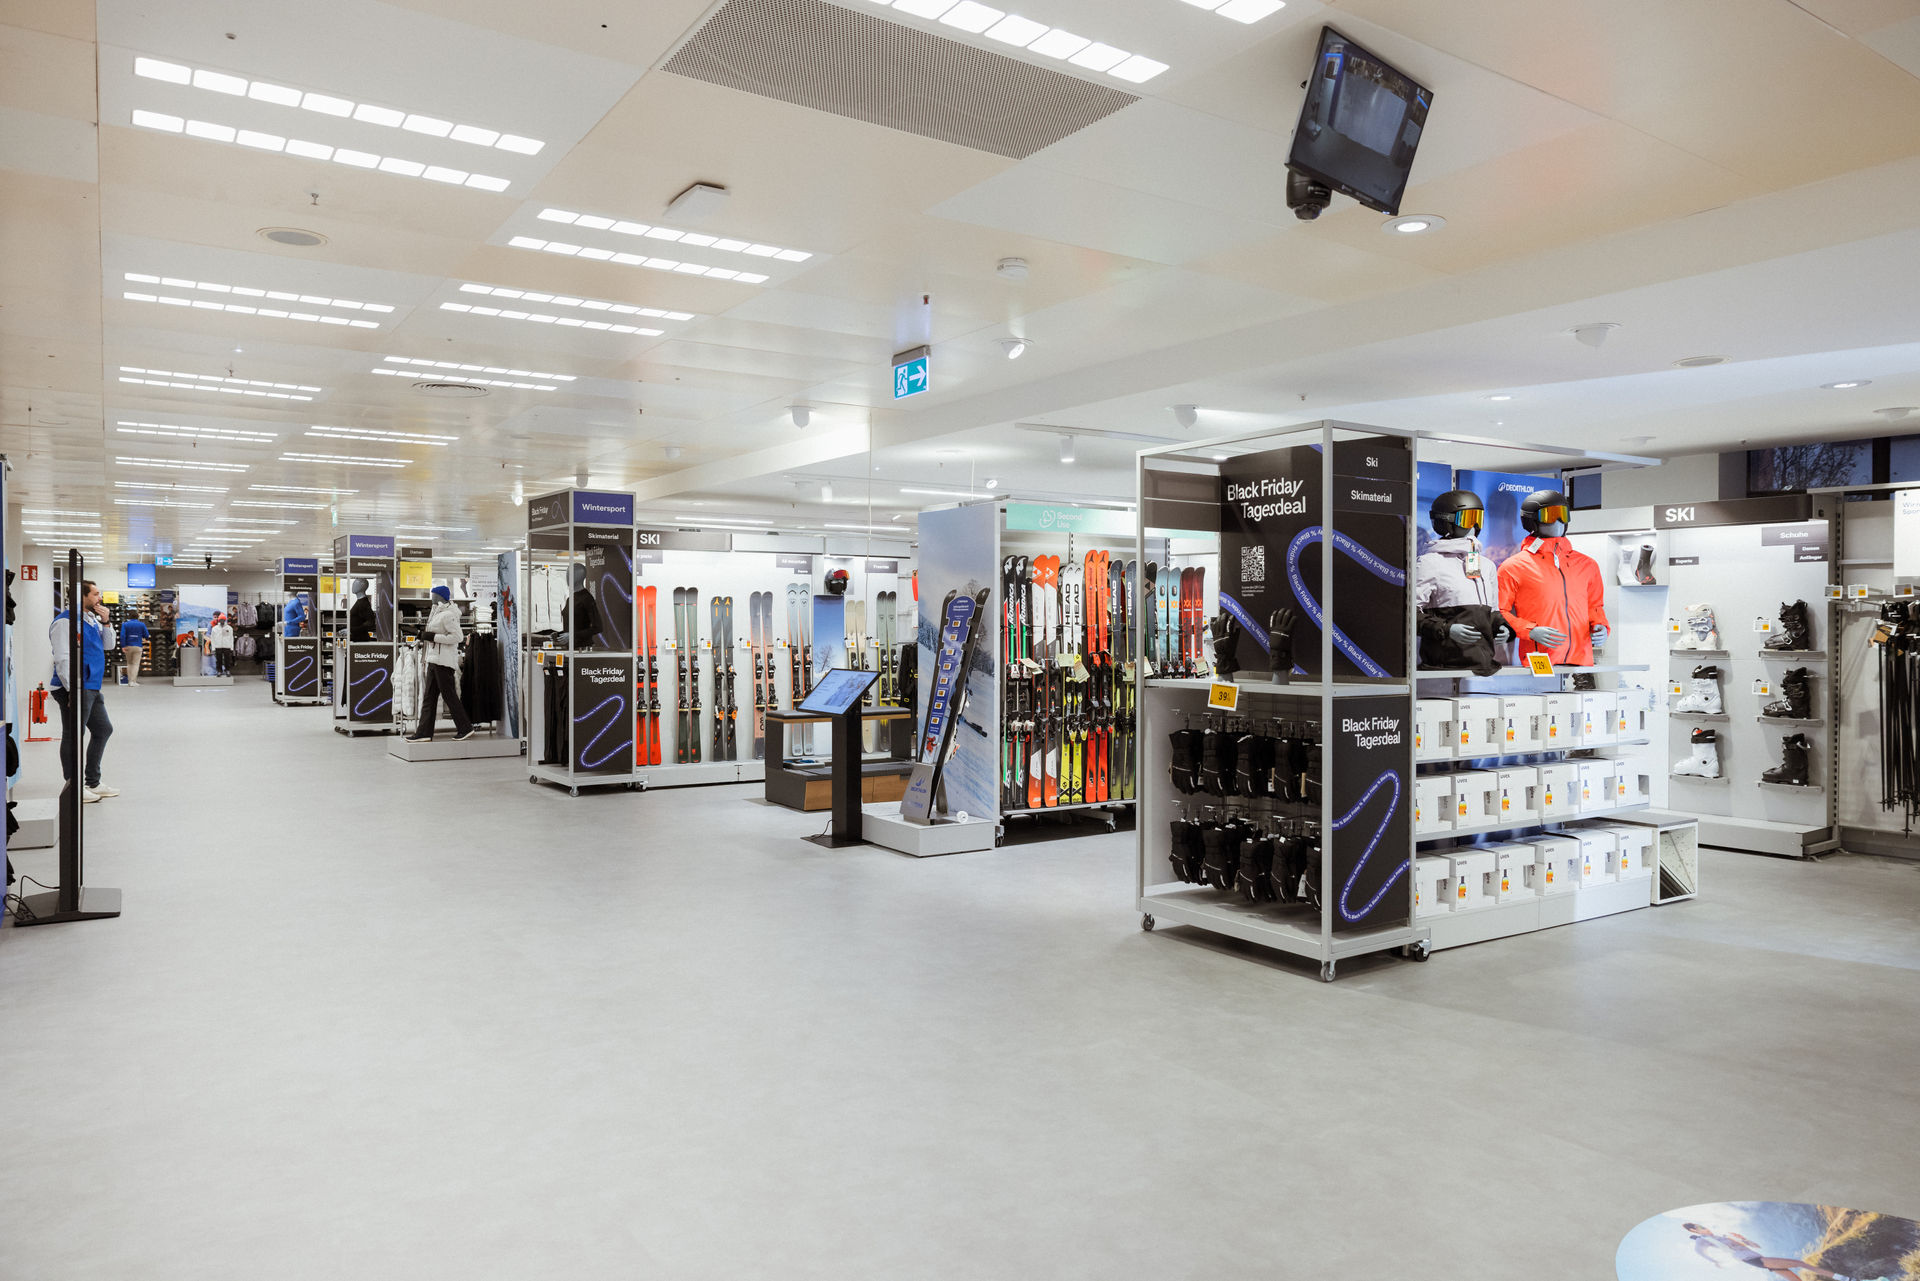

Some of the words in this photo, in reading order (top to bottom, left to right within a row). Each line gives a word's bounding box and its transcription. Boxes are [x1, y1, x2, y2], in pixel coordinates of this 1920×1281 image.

[1366, 457, 1378, 467] Ski
[1227, 481, 1259, 501] Black
[1261, 477, 1303, 497] Friday
[1505, 483, 1534, 493] DECATHLON
[1351, 489, 1392, 503] Skimaterial
[582, 503, 626, 513] Wintersport
[1241, 496, 1306, 521] Tagesdeal
[1665, 507, 1695, 522] SKI
[1057, 512, 1083, 520] Second
[640, 534, 660, 545] SKI
[1336, 536, 1351, 549] Black
[1780, 531, 1809, 539] Schuhe
[1289, 545, 1297, 565] Friday
[1357, 548, 1373, 565] Friday
[1373, 560, 1389, 575] Black
[1292, 574, 1301, 591] Black
[1300, 590, 1312, 609] Friday
[1347, 645, 1362, 661] Black
[1361, 658, 1377, 675] Friday
[602, 668, 624, 676] Friday
[590, 676, 625, 684] Tagesdeal
[1342, 718, 1370, 732] Black
[1371, 716, 1399, 732] Friday
[1355, 731, 1400, 749] Tagesdeal
